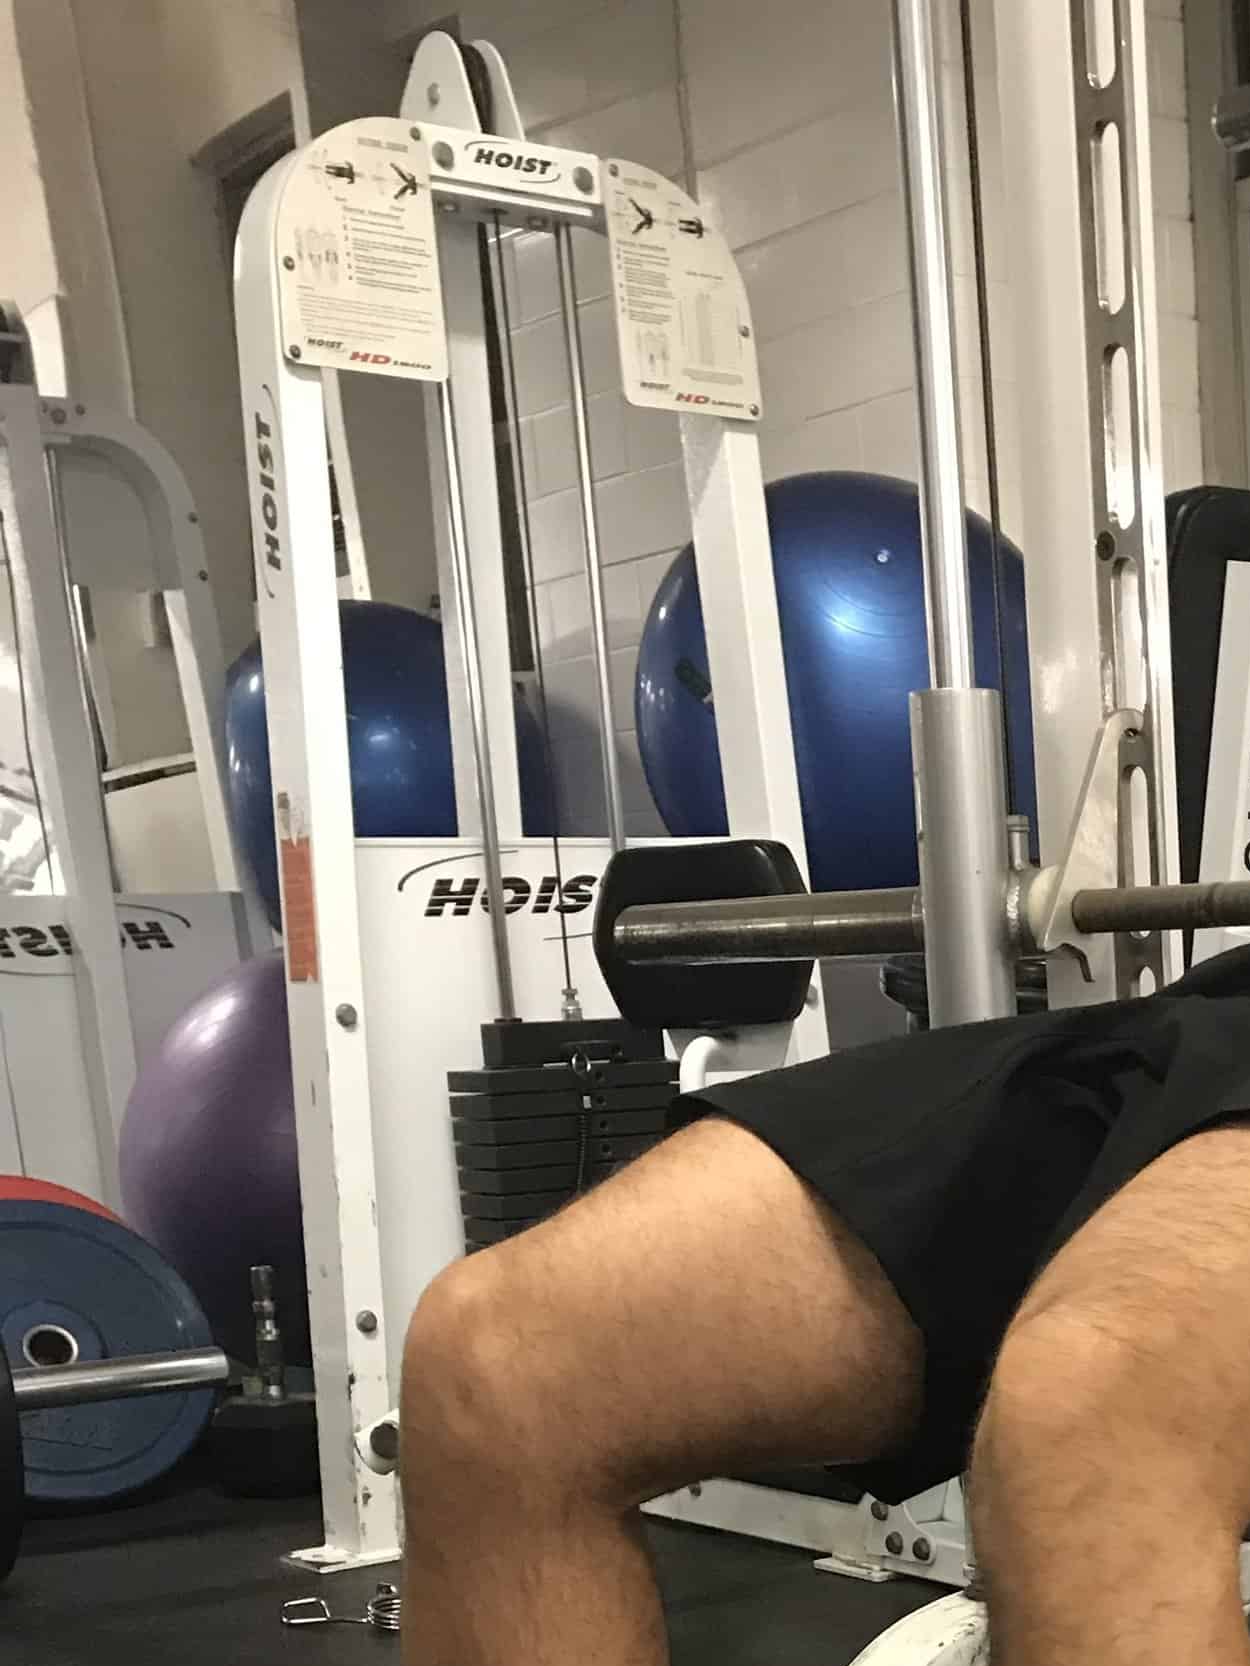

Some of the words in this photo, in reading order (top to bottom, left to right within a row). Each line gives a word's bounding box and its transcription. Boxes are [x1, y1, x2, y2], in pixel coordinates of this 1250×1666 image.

[474, 148, 552, 175] HOIST
[349, 351, 392, 365] HD
[255, 412, 281, 571] HOIST
[424, 875, 601, 917] HOIS
